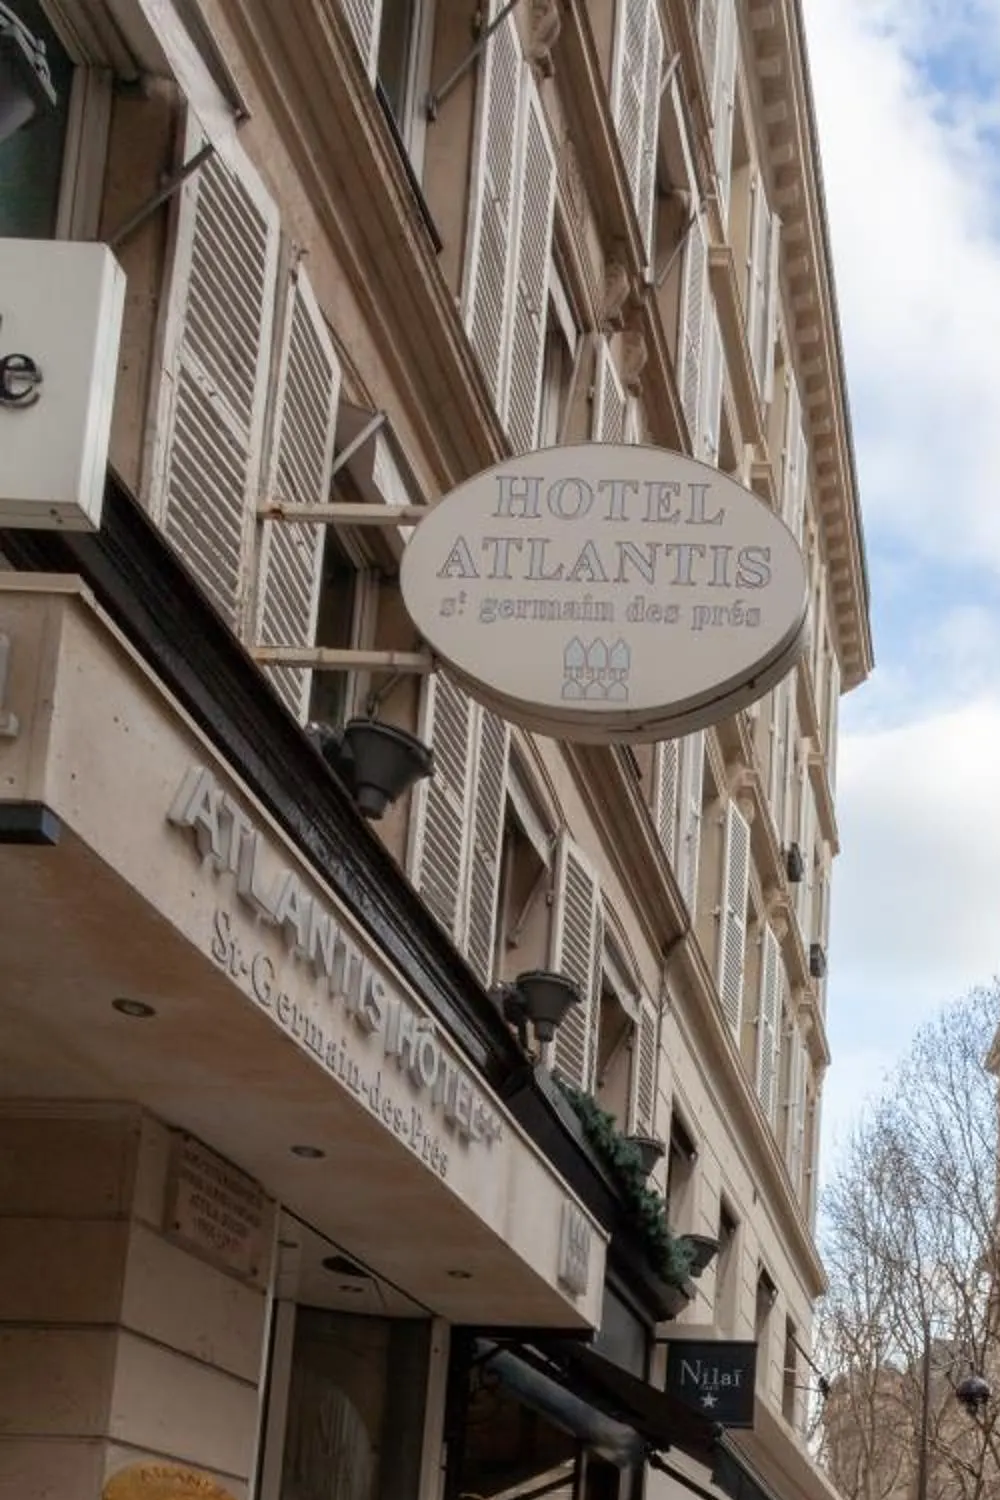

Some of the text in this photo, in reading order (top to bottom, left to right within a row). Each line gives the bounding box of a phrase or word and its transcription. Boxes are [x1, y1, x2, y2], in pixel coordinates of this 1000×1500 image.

[491, 474, 726, 526] HOTEL
[435, 534, 773, 589] ATLANTIS
[479, 592, 615, 624] germain
[626, 595, 681, 624] des
[691, 599, 761, 631] prés
[166, 765, 386, 1034] ATLANTIS
